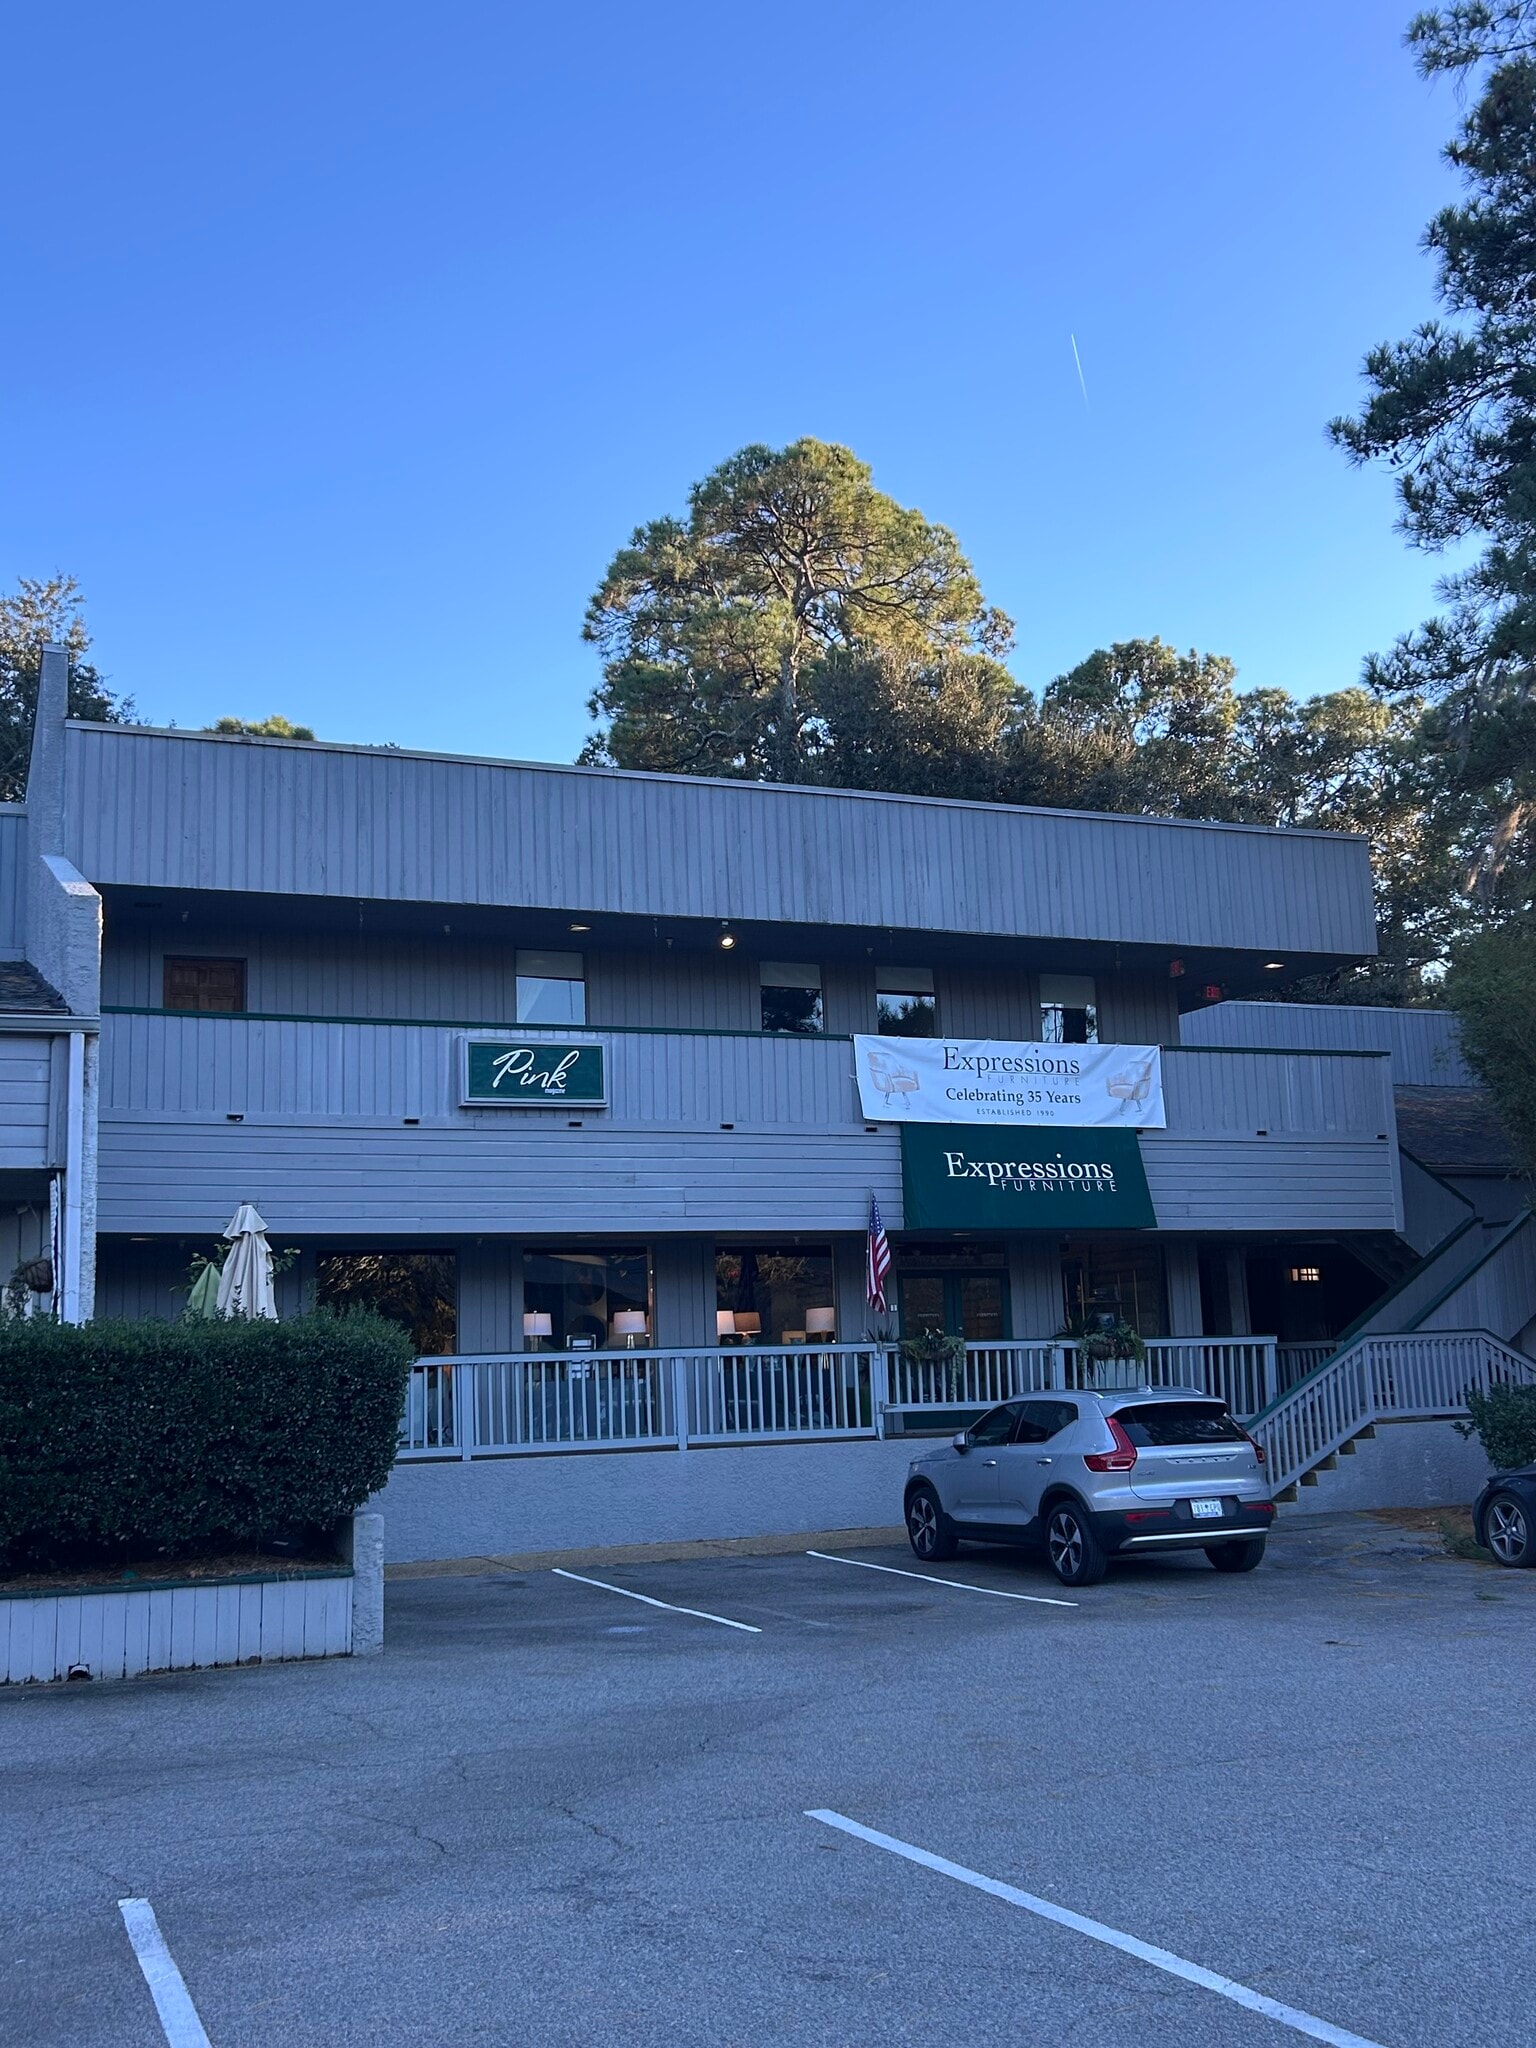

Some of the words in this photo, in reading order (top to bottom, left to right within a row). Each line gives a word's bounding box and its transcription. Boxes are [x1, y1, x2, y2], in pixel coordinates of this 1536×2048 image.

[492, 1049, 580, 1088] Pink
[943, 1046, 1080, 1078] Expressions
[987, 1076, 1080, 1087] FURNITURE
[945, 1087, 1024, 1106] Celebrating
[1027, 1091, 1042, 1103] 35
[1046, 1091, 1081, 1104] Years
[976, 1108, 1032, 1116] ESTABLISHED
[943, 1151, 1114, 1186] Expressions
[1001, 1180, 1117, 1192] FURNITURE
